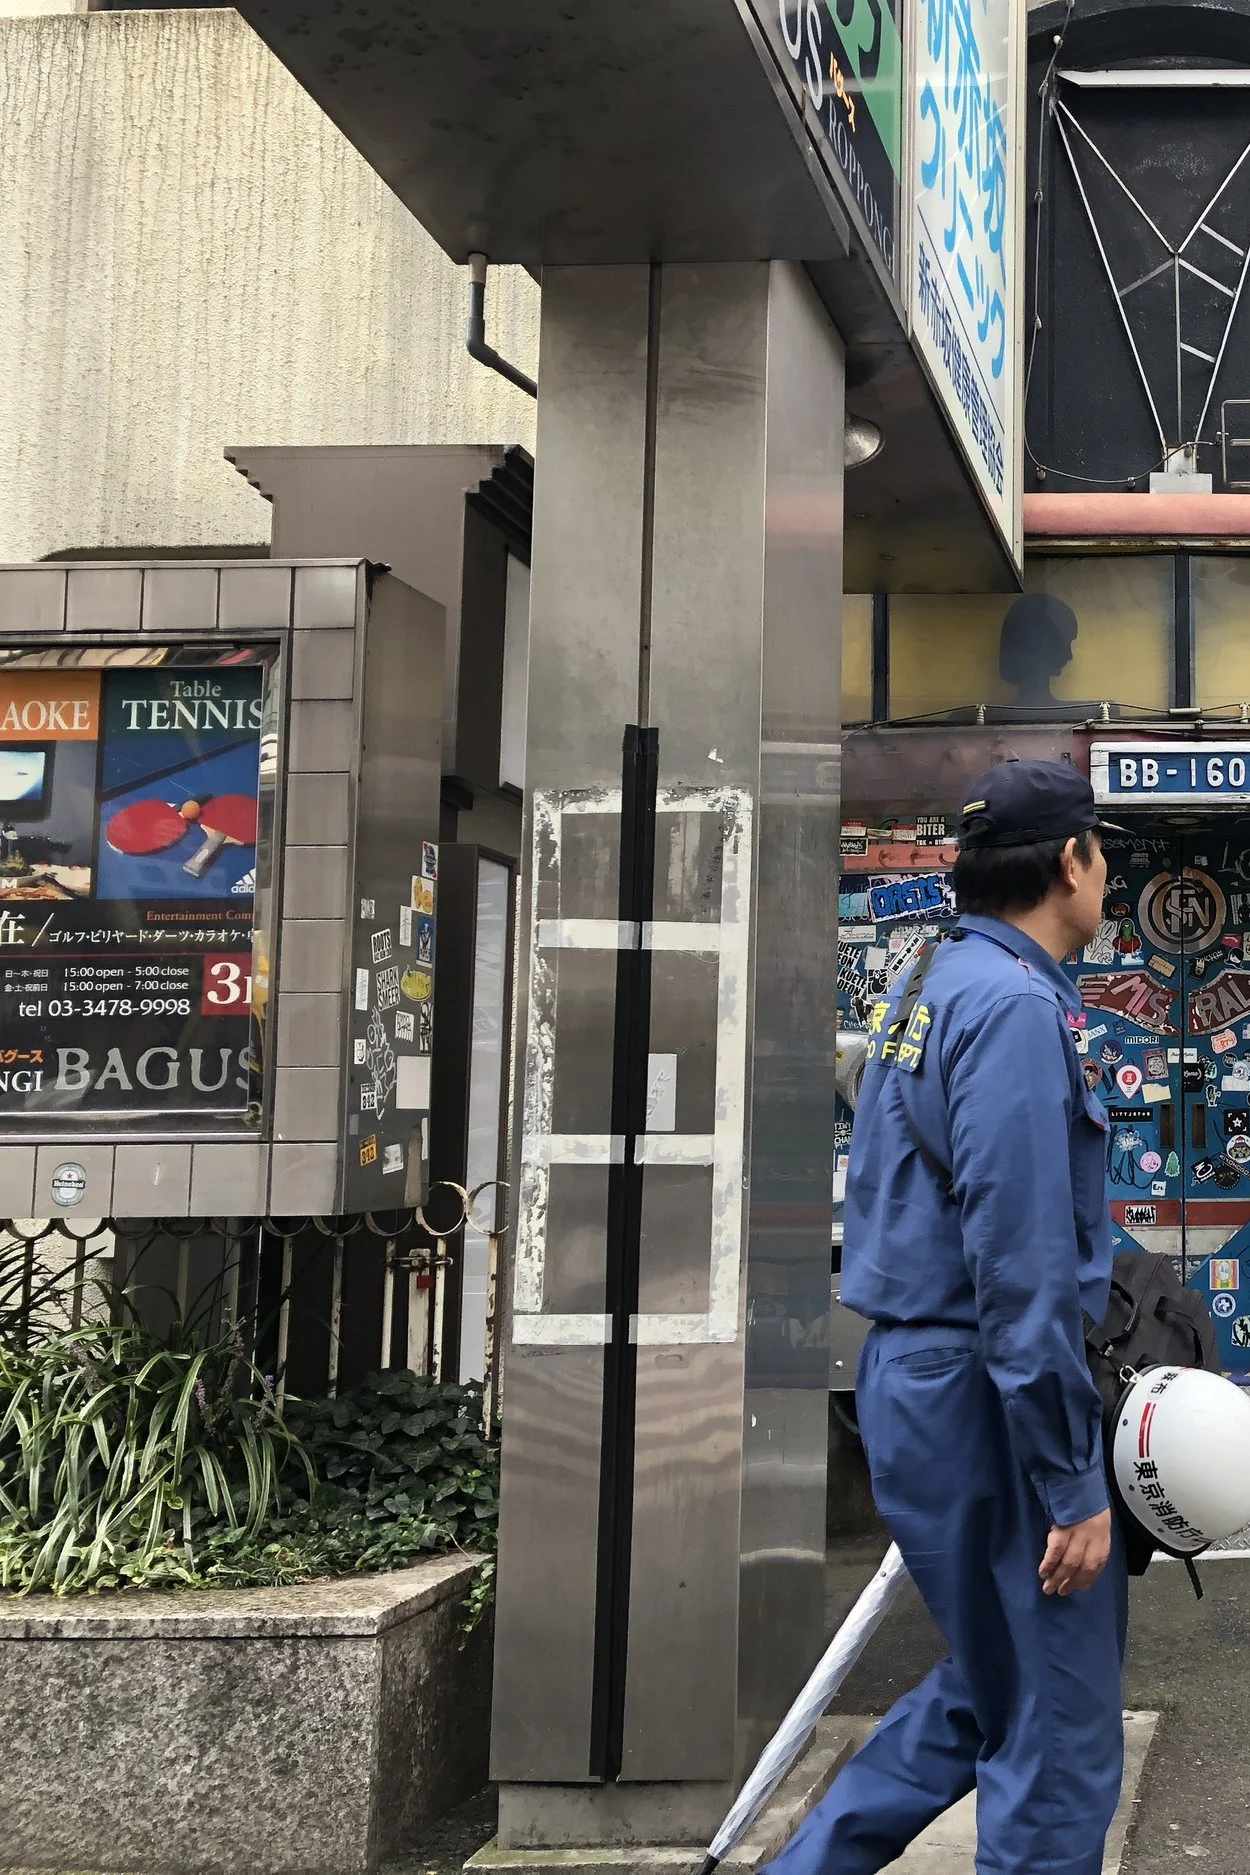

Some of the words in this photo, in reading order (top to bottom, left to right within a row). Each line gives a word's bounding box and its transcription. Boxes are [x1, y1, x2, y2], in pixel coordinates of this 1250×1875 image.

[828, 96, 895, 280] ROPPONGI
[171, 680, 223, 698] Table
[916, 823, 945, 836] BITER
[146, 910, 222, 921] Entertainment
[226, 910, 254, 921] Com
[63, 967, 94, 977] 15:00
[96, 968, 124, 981] open
[135, 966, 160, 977] 5:00
[161, 966, 190, 977] close
[376, 970, 399, 991] SHARK
[63, 981, 94, 991] 15:00
[95, 982, 123, 995] open
[134, 980, 160, 991] 7:00
[161, 980, 189, 991] close
[19, 1000, 42, 1017] tel
[48, 999, 191, 1017] 03-3478-9998
[1125, 1036, 1160, 1044] MIDORI
[1133, 1460, 1206, 1542] 東京消防庁
